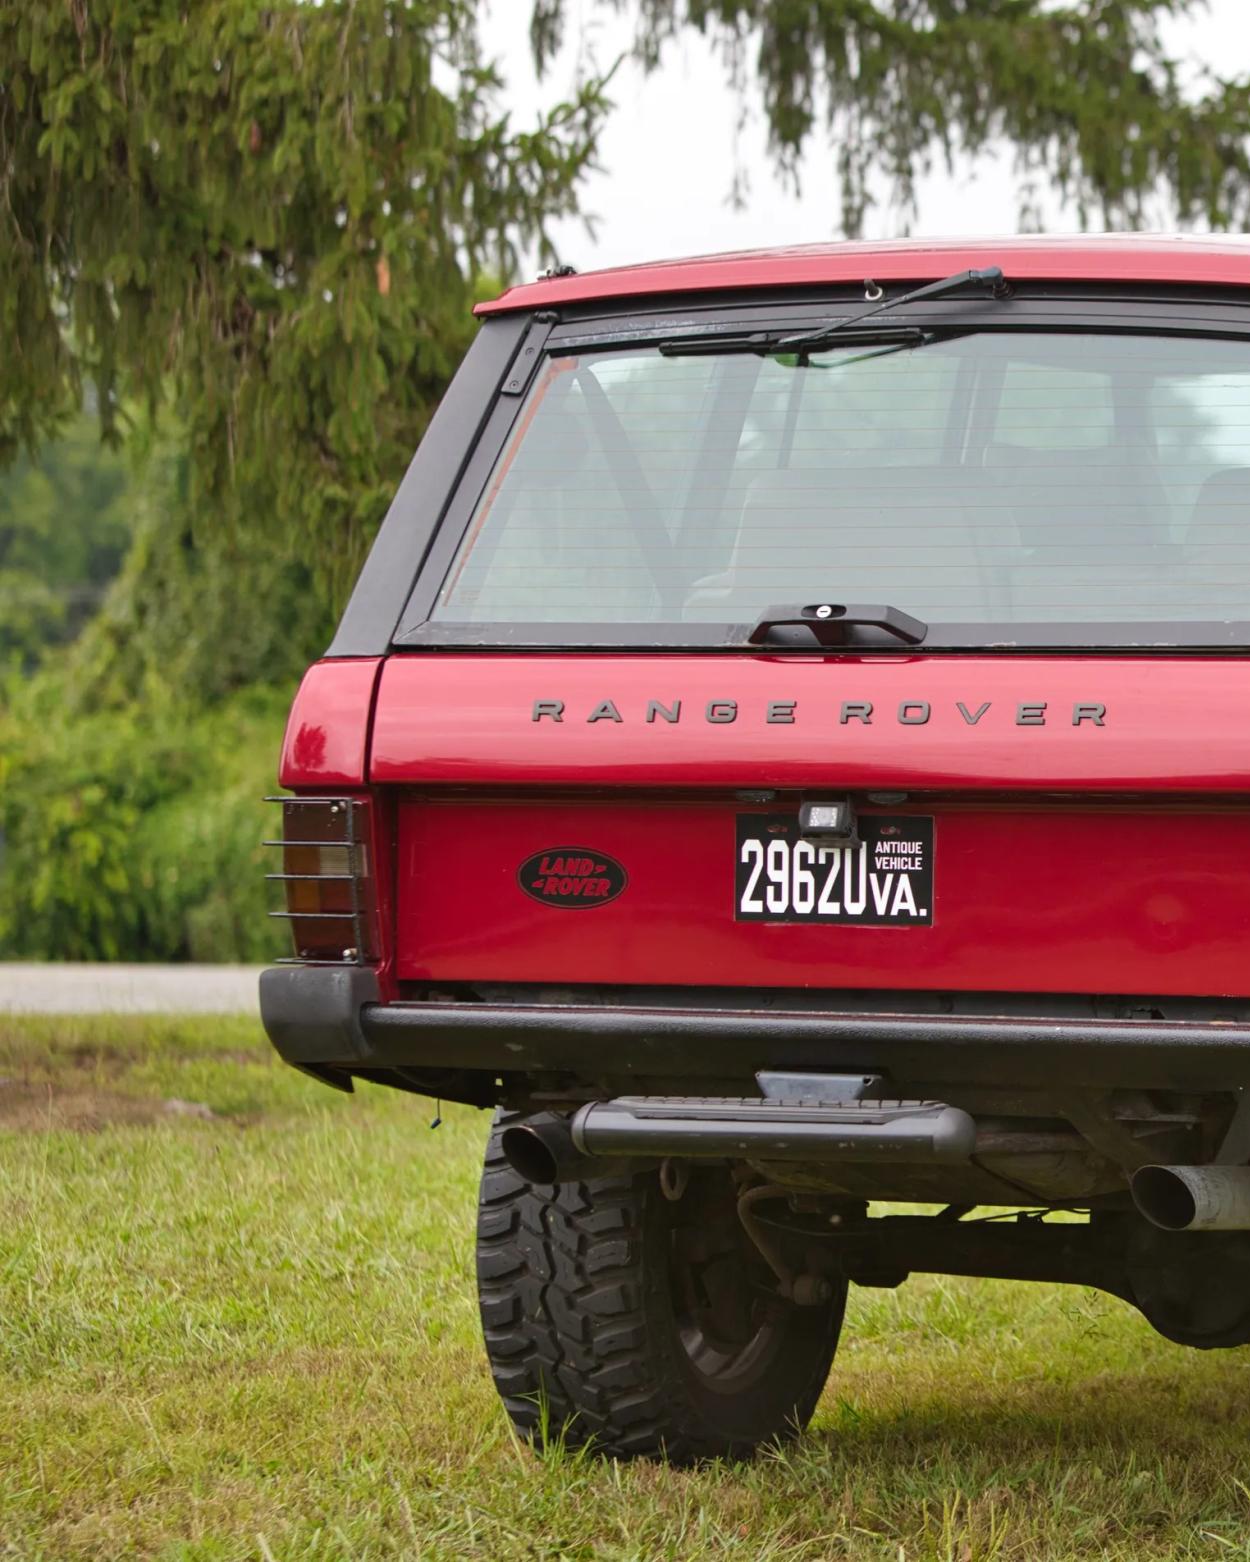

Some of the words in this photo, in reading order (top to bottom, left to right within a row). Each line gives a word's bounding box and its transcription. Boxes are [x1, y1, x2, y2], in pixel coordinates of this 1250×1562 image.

[531, 700, 796, 724] RANGE
[839, 702, 1106, 726] ROVER
[875, 841, 923, 854] ANTIQUE
[875, 857, 923, 870] VEHICLE
